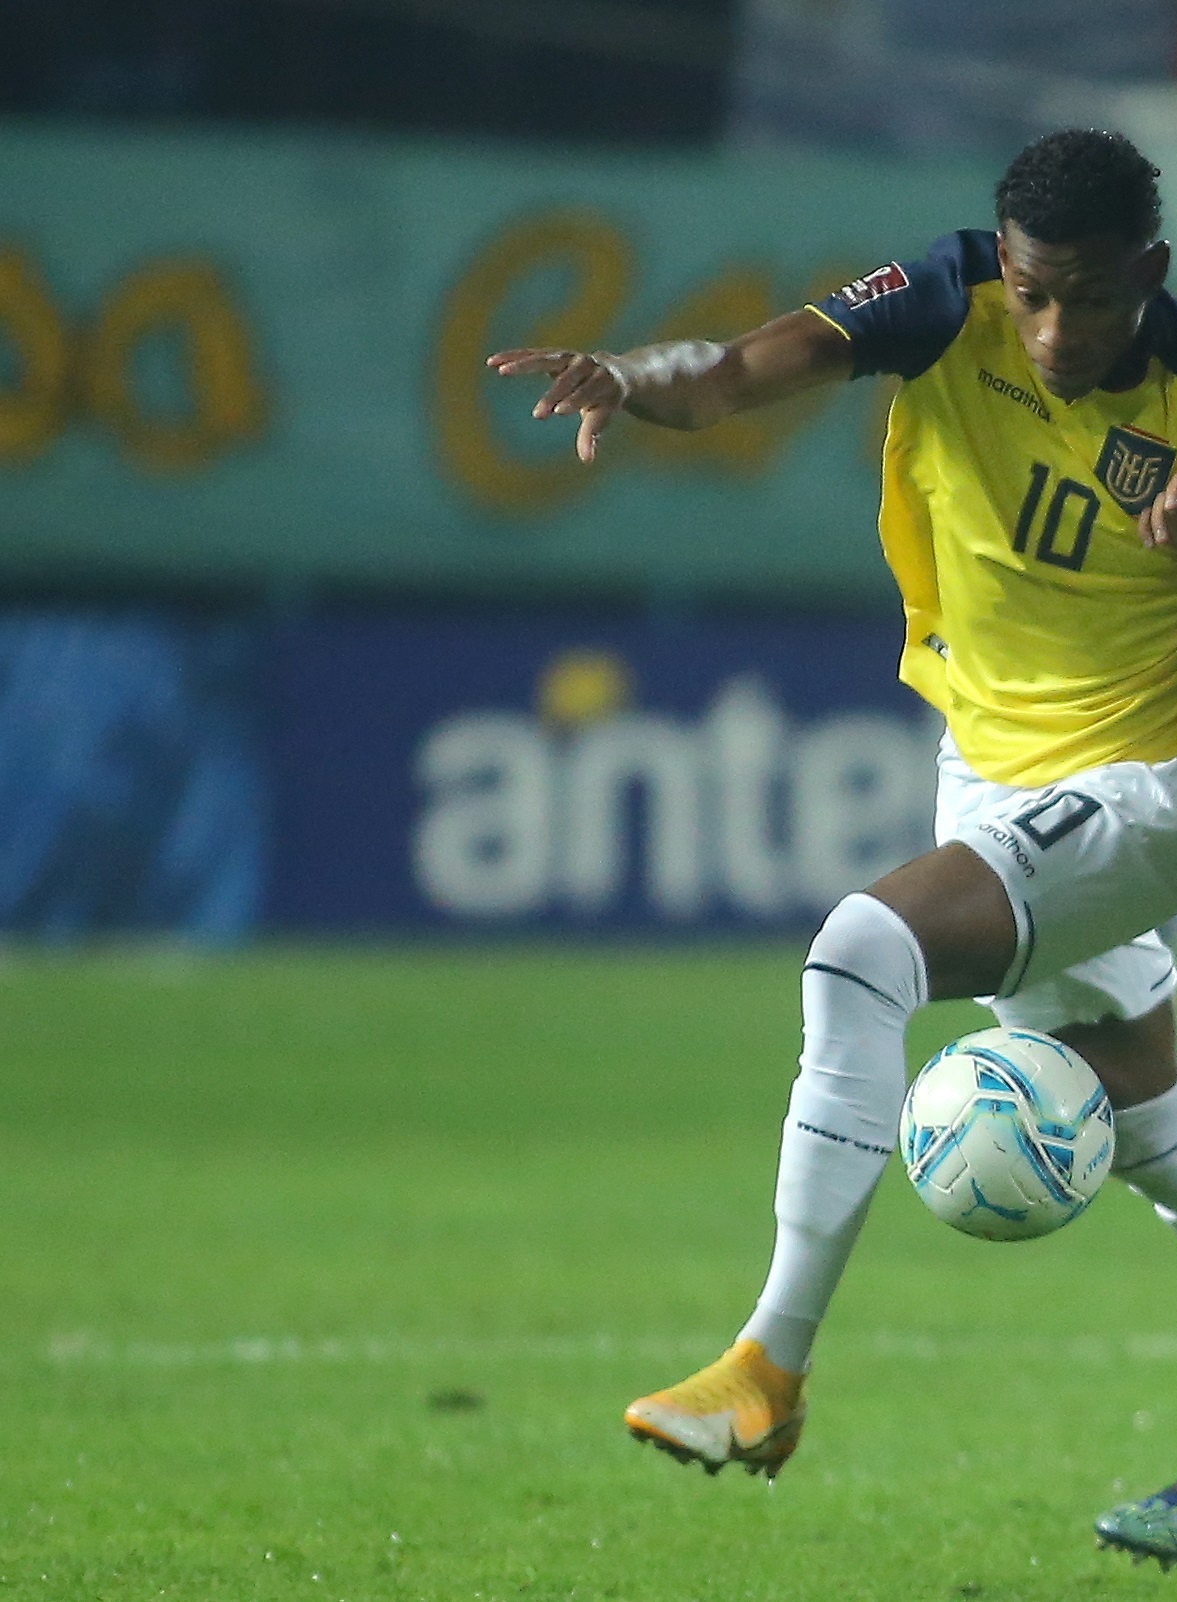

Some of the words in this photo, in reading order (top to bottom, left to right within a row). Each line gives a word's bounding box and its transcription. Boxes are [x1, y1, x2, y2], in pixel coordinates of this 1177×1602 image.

[977, 367, 1051, 423] maratho
[1012, 461, 1101, 572] 10
[413, 674, 944, 912] ante
[977, 823, 1036, 878] arathon
